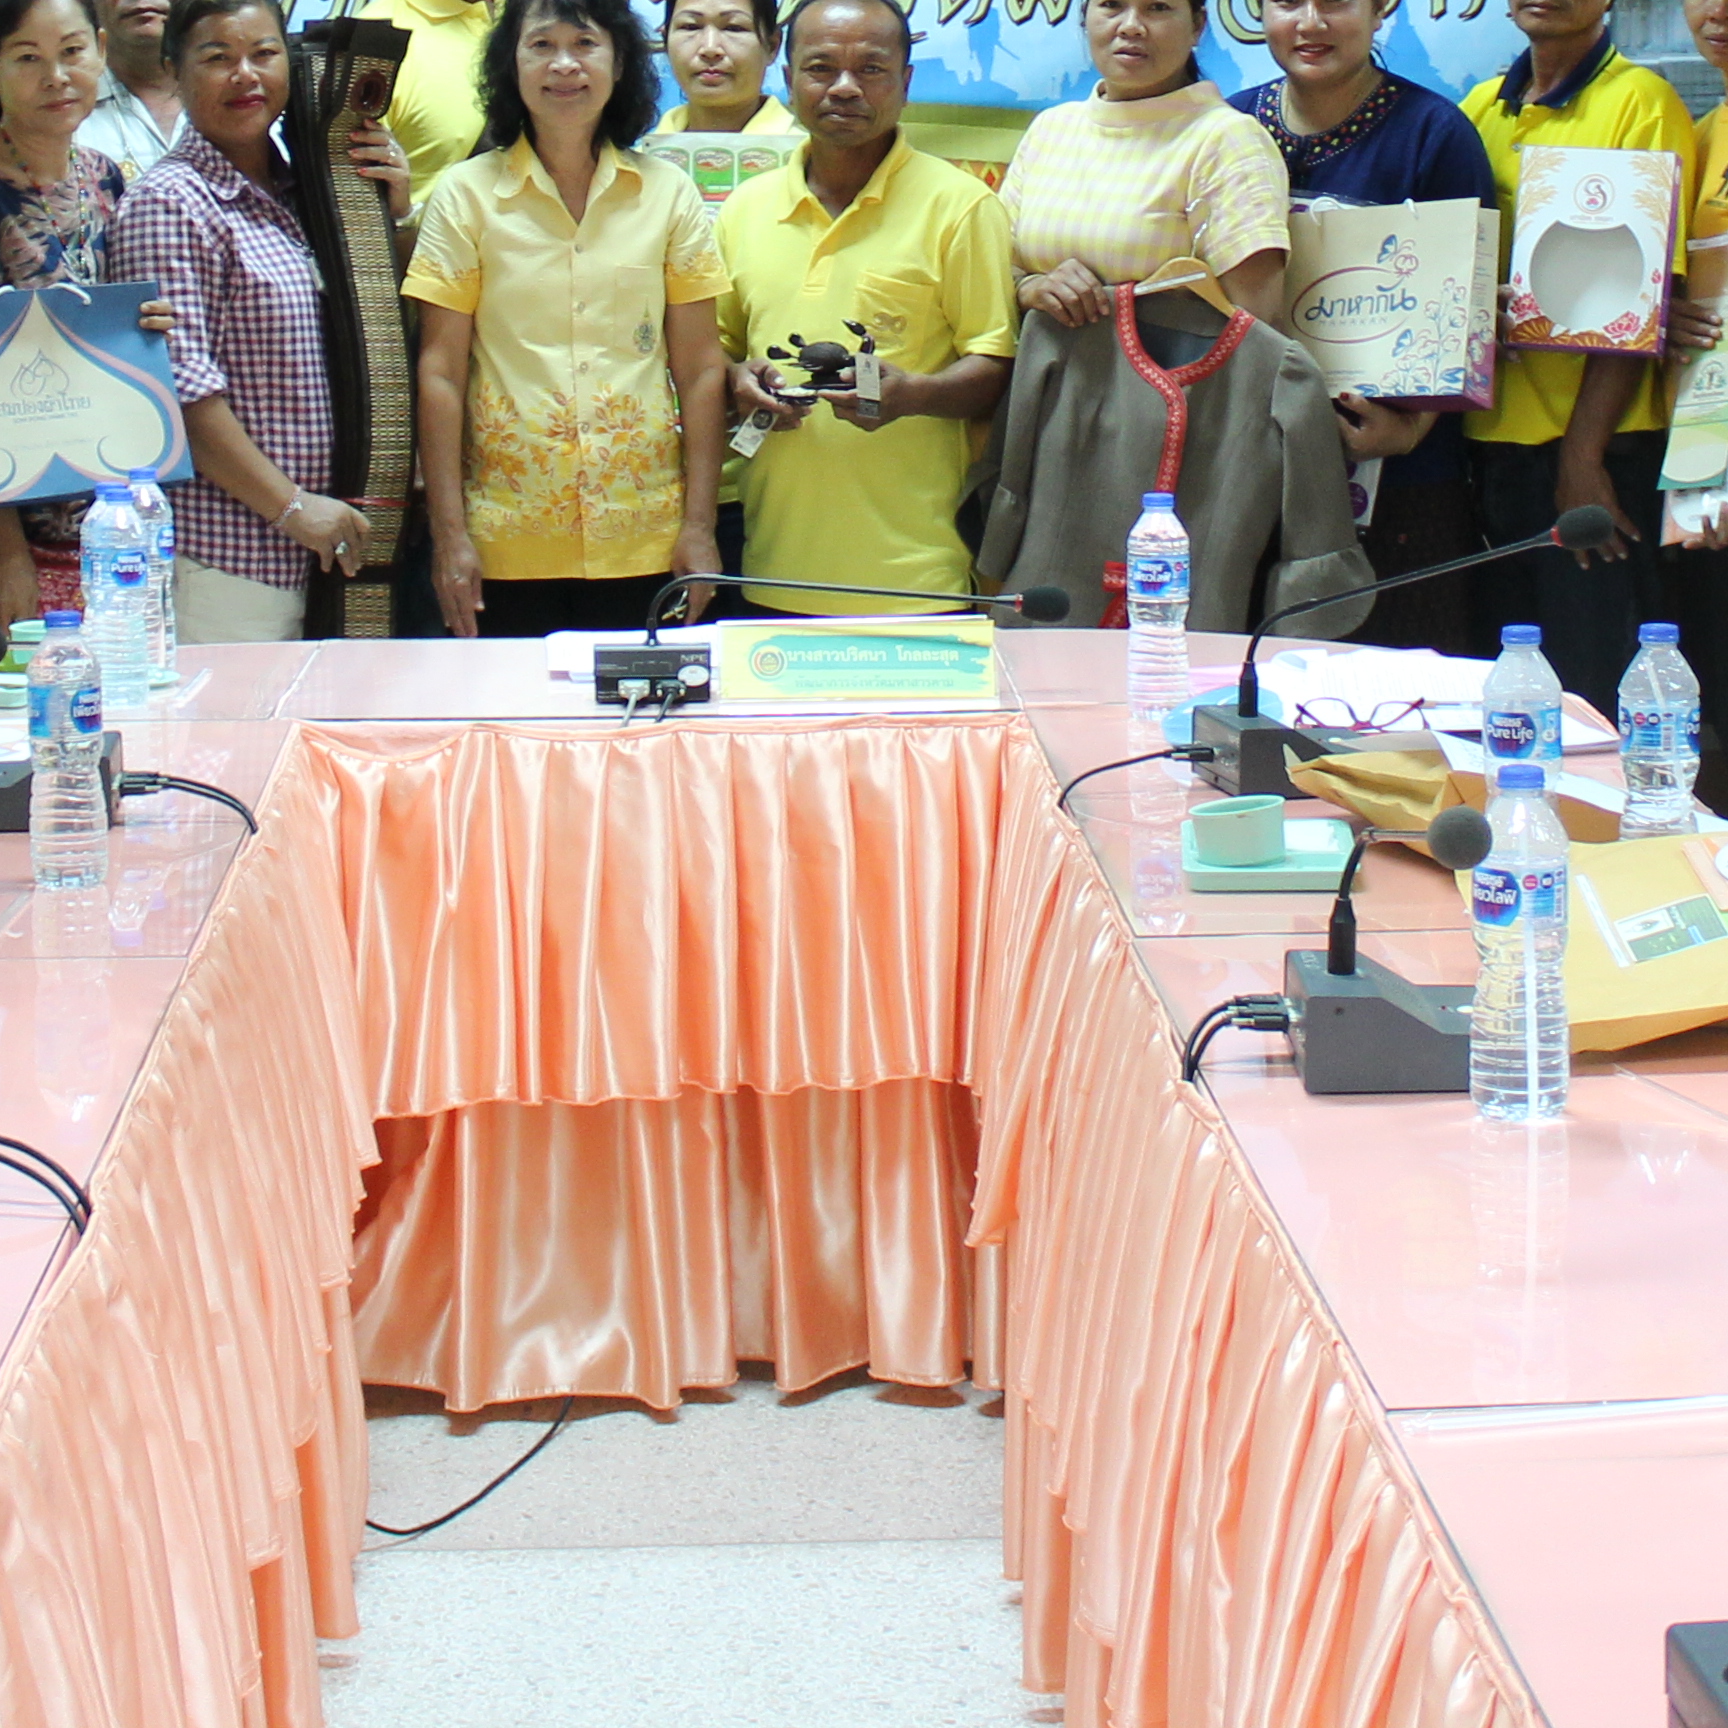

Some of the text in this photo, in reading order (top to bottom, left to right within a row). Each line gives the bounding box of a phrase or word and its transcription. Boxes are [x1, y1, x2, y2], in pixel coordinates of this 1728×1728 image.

[1305, 278, 1418, 321] มาหากัน
[1486, 724, 1534, 744] Pure Life
